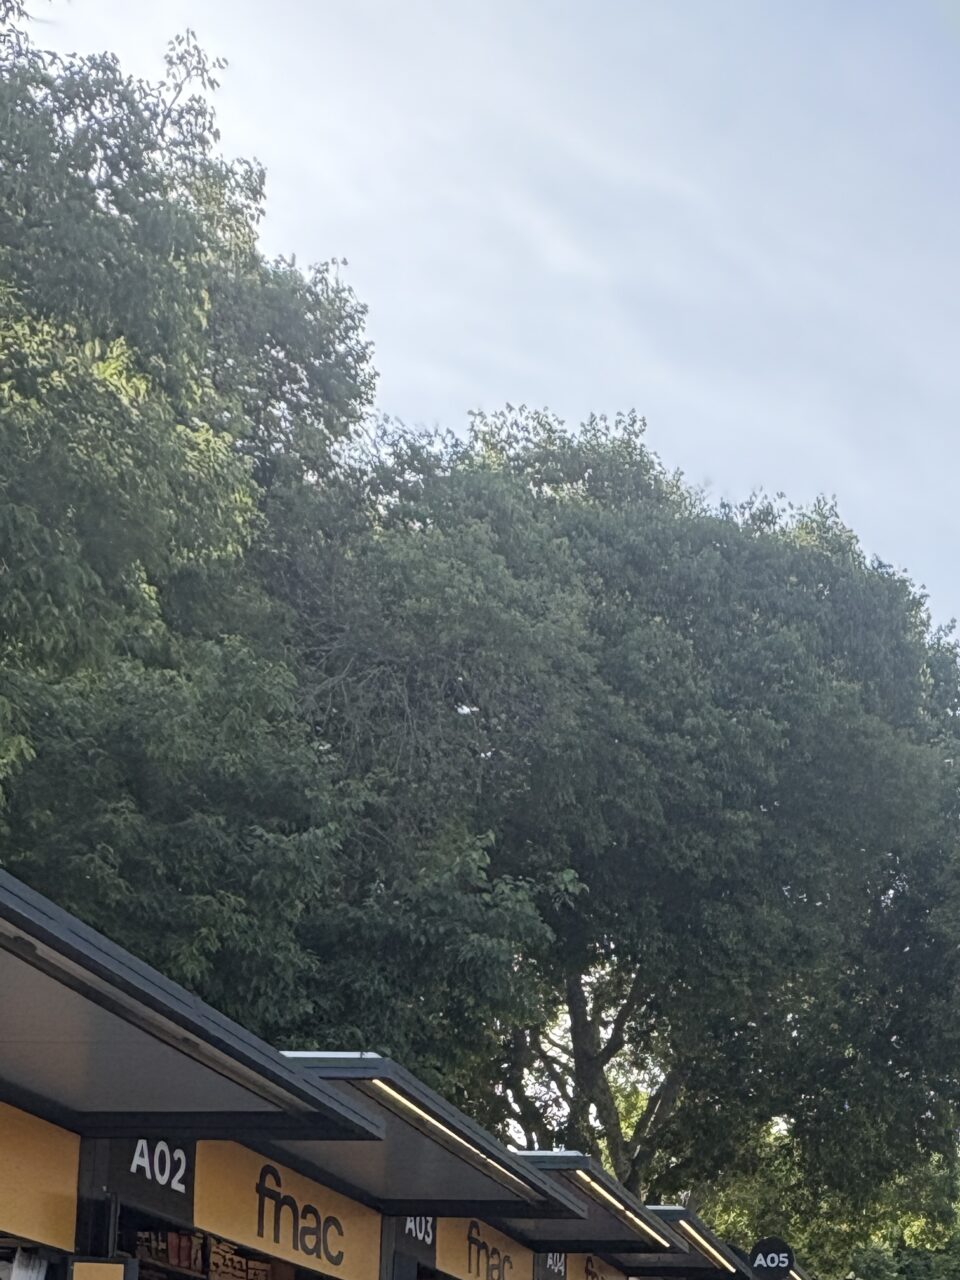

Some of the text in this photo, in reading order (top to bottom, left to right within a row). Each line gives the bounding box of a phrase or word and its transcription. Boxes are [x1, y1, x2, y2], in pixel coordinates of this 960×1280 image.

[130, 1139, 186, 1193] A02
[256, 1164, 344, 1266] fnac
[405, 1217, 433, 1245] A03
[753, 1253, 789, 1268] A05
